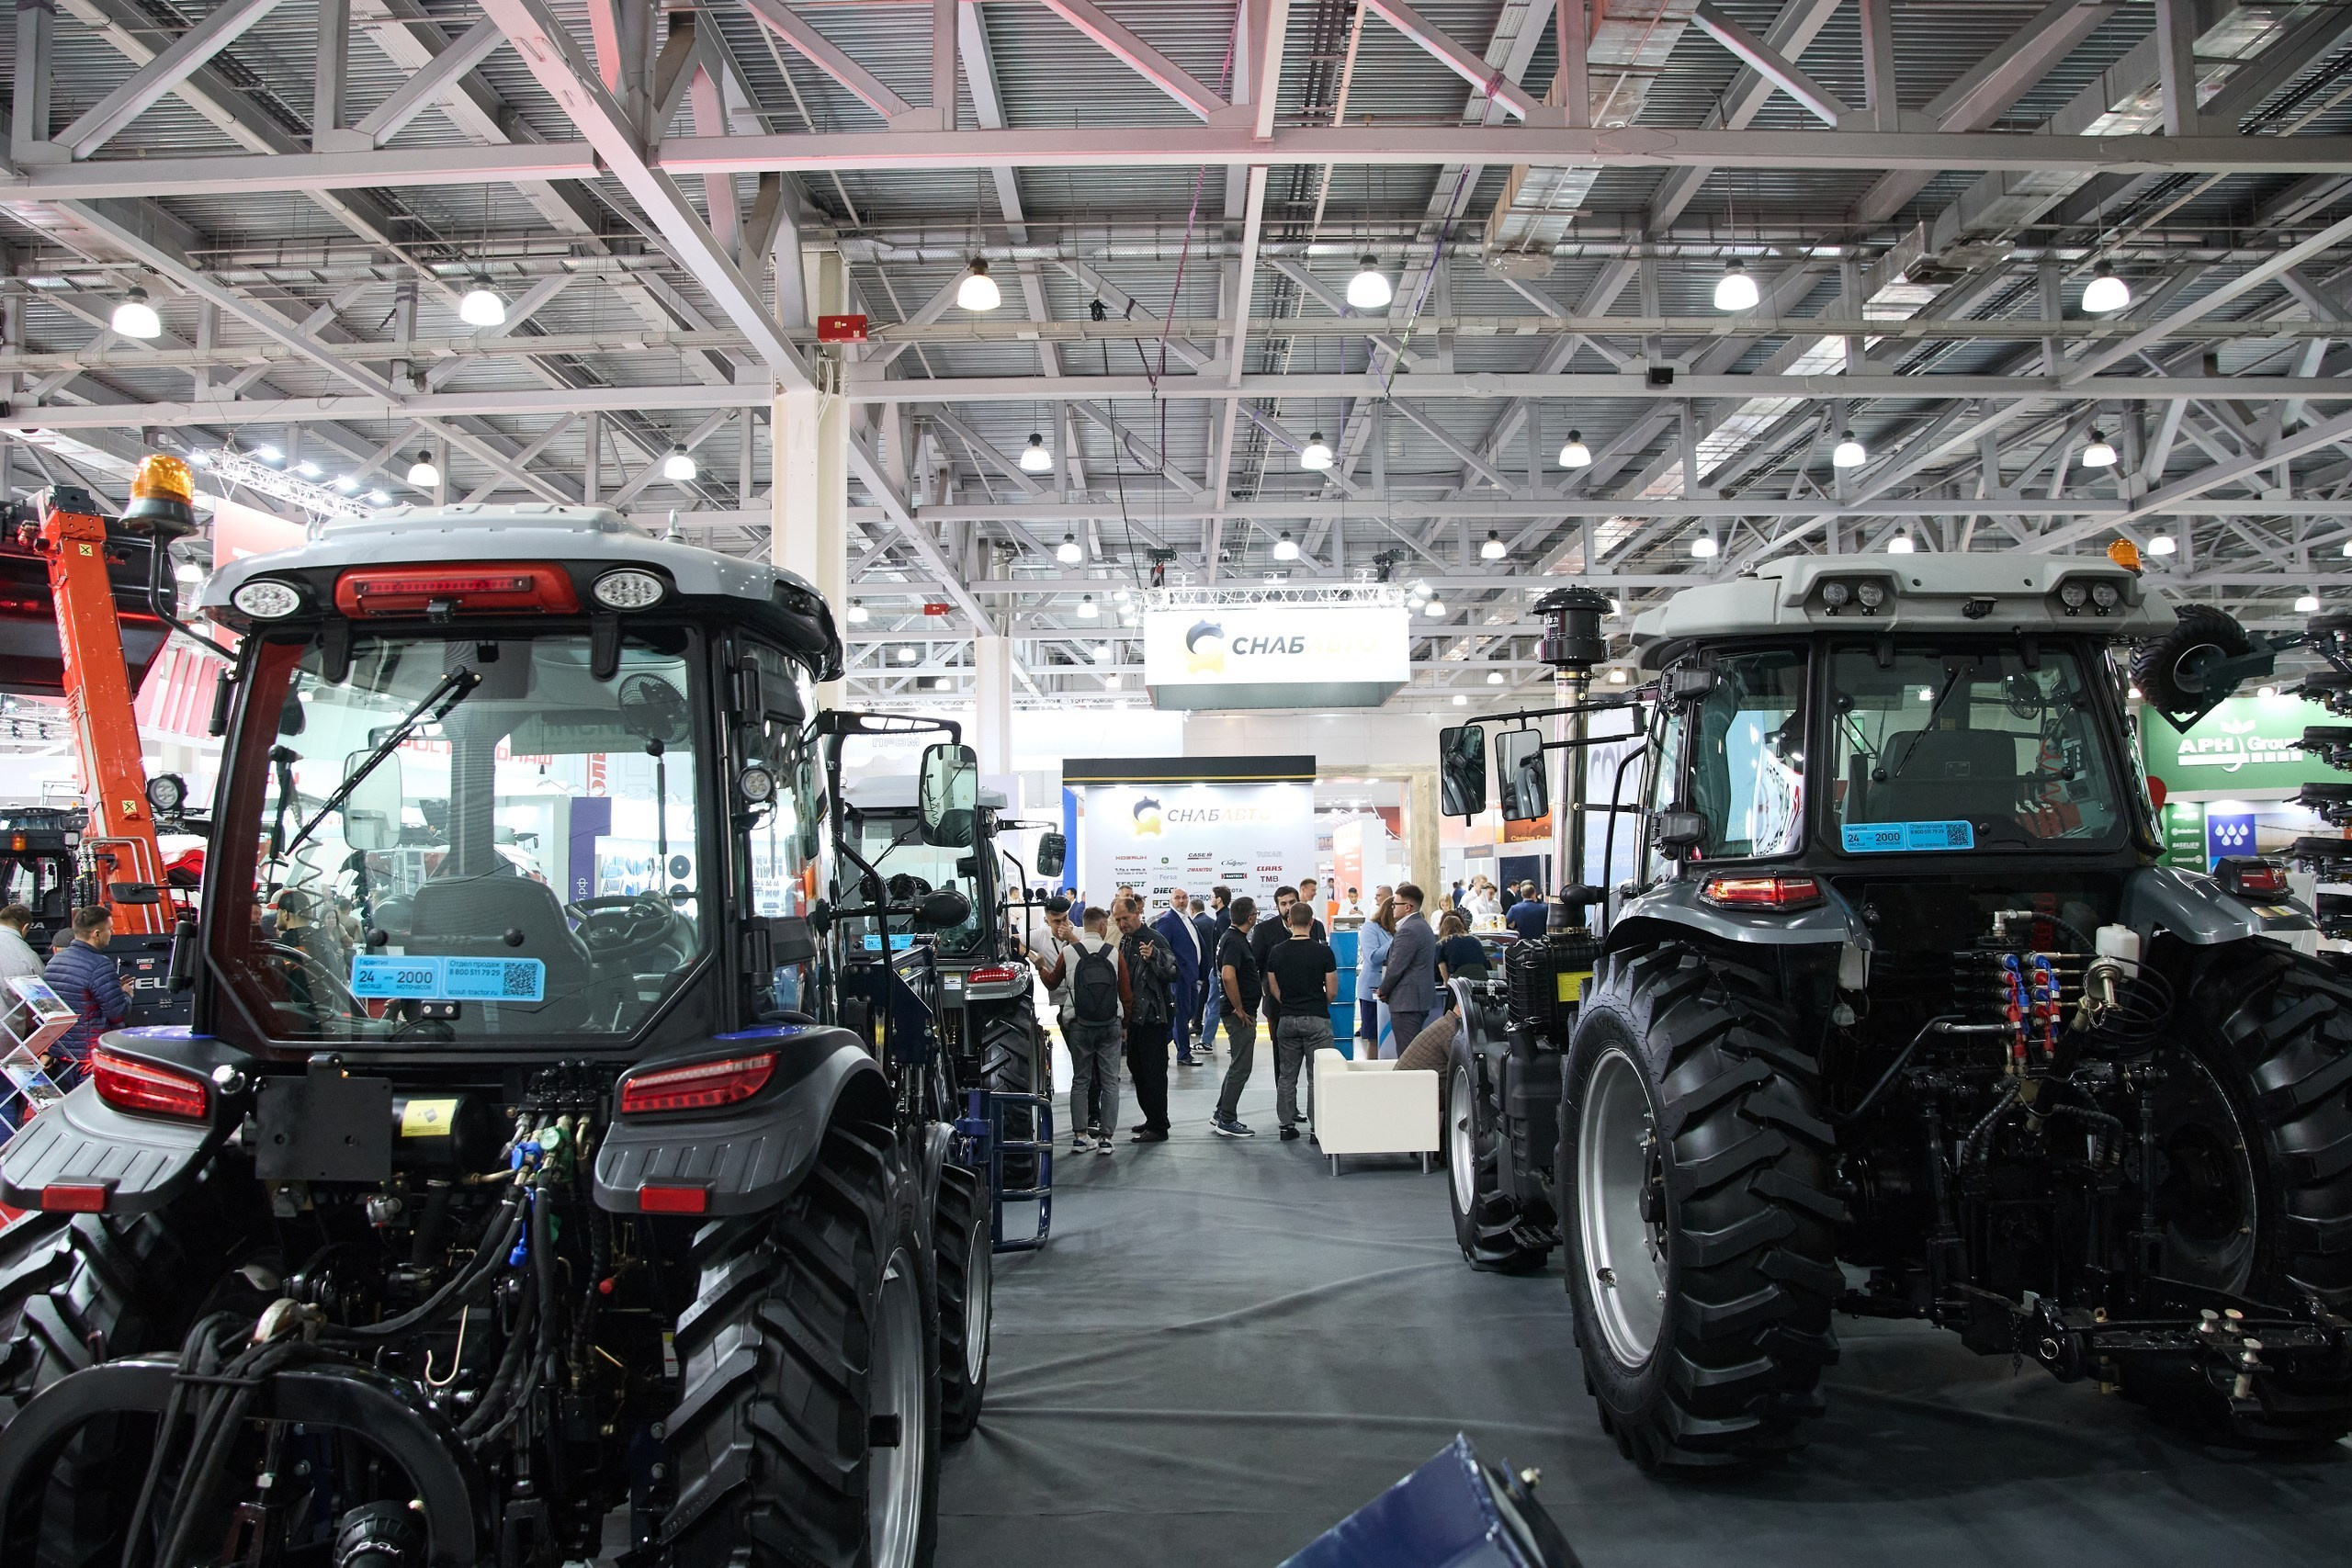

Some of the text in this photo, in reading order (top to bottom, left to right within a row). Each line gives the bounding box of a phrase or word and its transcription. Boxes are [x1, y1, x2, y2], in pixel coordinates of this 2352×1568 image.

[2177, 738, 2234, 754] APH
[1848, 834, 1859, 842] 24
[1876, 833, 1900, 841] 2000
[359, 970, 374, 983] 24
[397, 971, 433, 983] 2000
